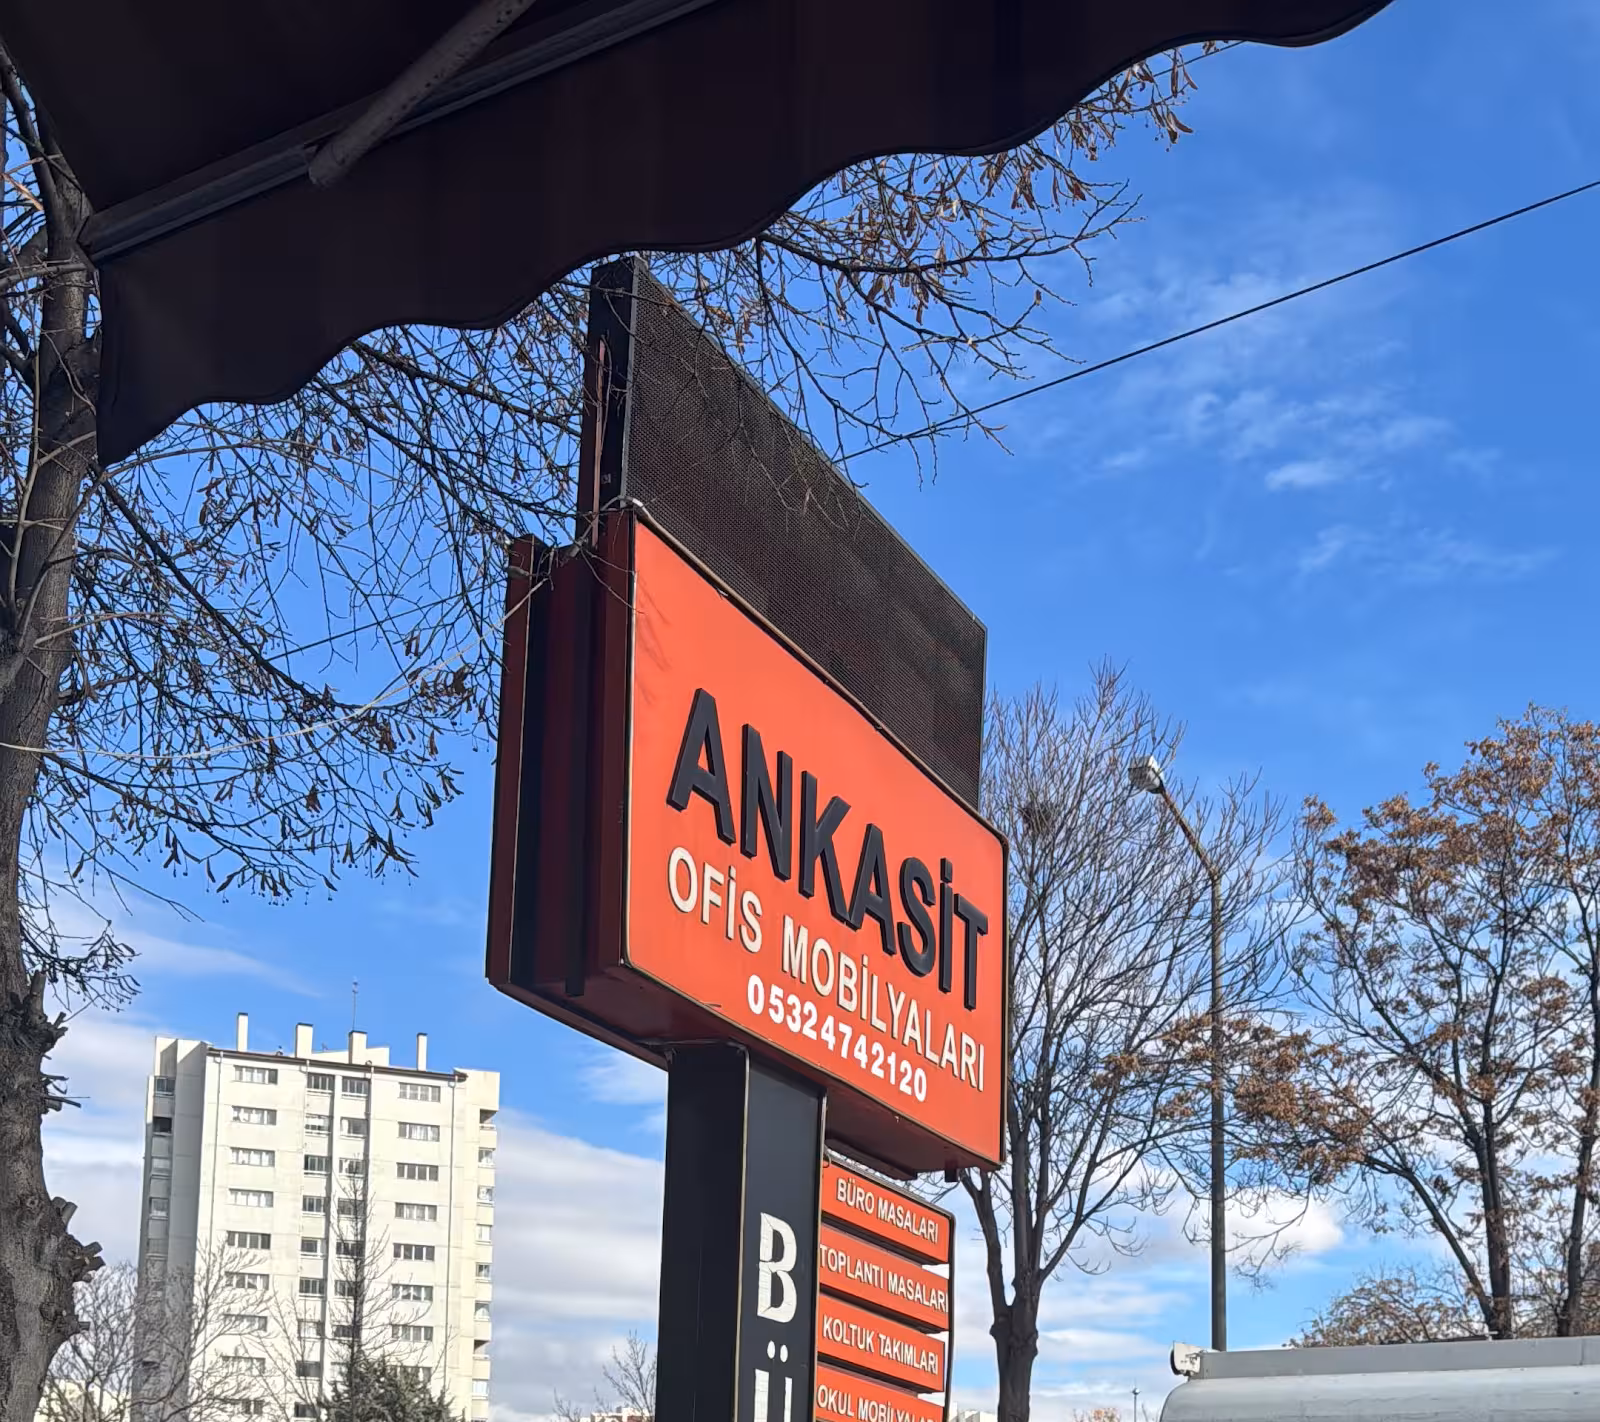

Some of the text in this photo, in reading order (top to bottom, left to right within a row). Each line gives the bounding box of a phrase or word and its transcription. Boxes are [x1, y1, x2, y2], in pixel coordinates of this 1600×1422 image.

[666, 687, 989, 1012] ANKASİT
[668, 846, 986, 1091] OFİS MOBİLYALARI
[747, 974, 928, 1102] 05324742120
[837, 1178, 939, 1244] BÜRO MASALARI
[819, 1243, 949, 1313] TOPLANTI MASALARI
[822, 1314, 939, 1376] KOLTUK TAKIMLARI
[817, 1384, 854, 1417] OKUL
